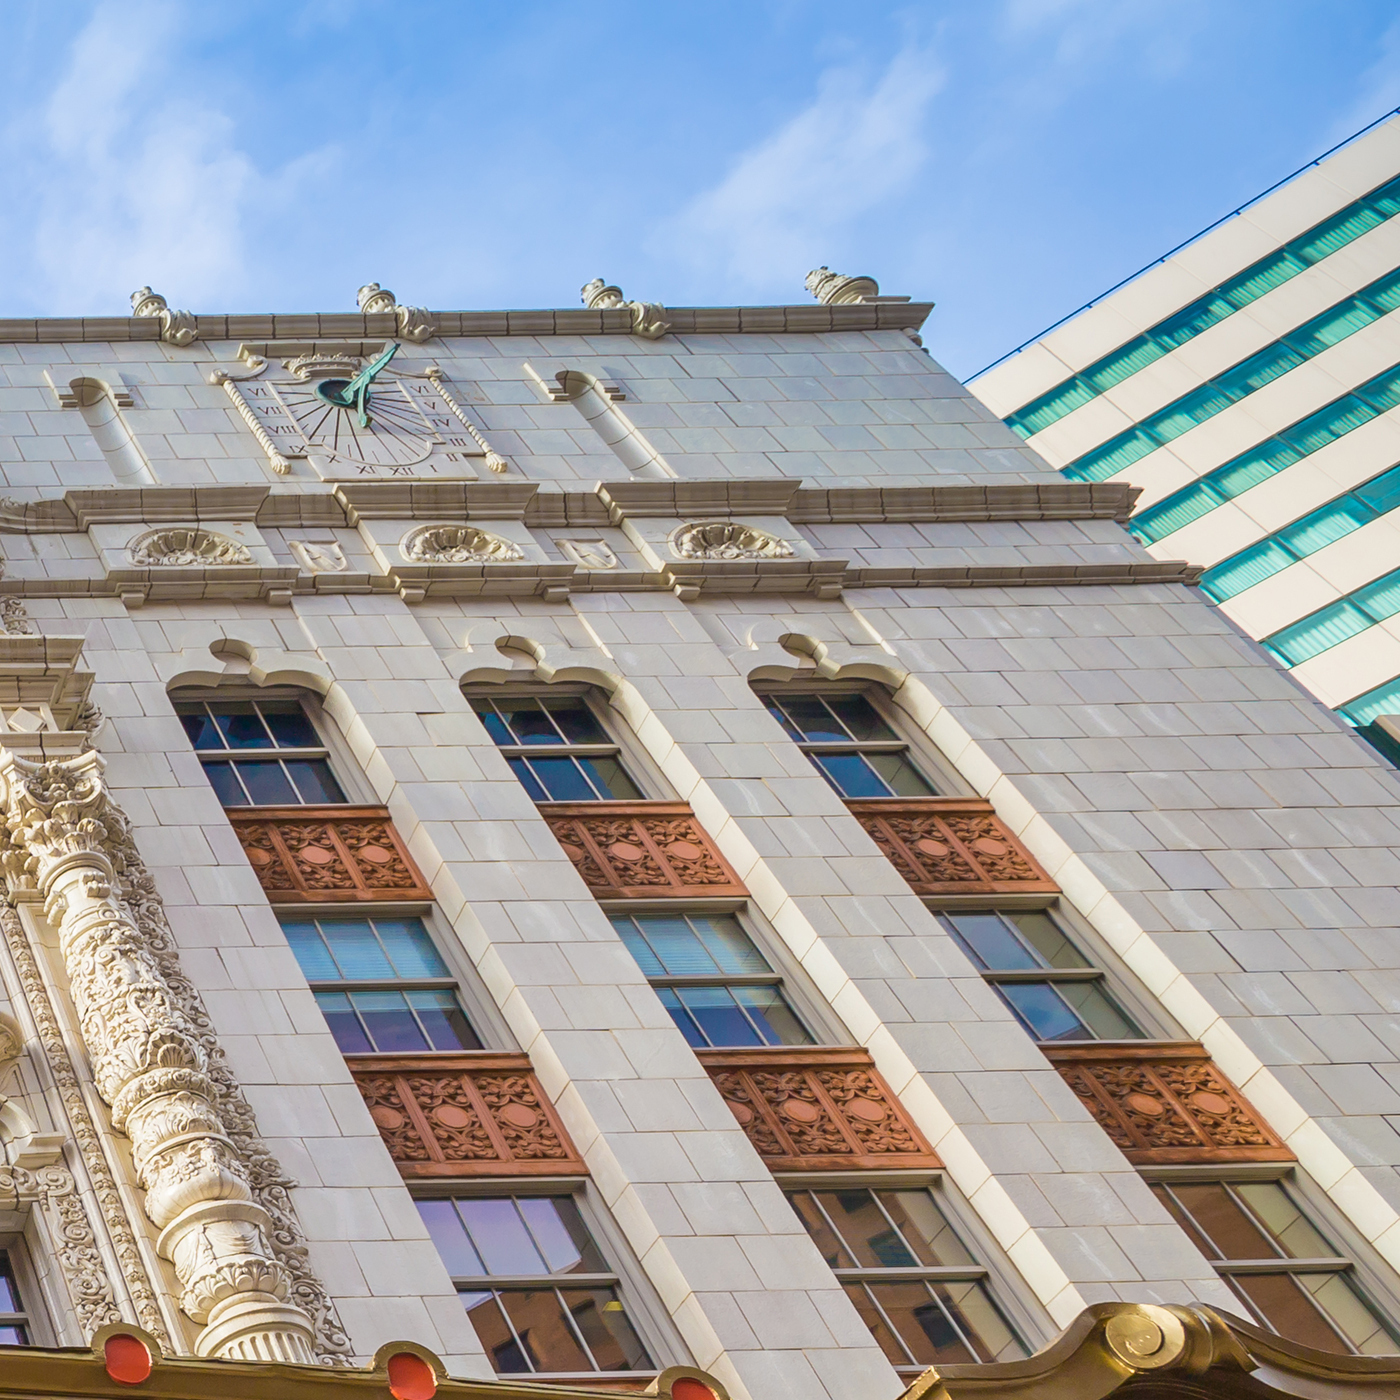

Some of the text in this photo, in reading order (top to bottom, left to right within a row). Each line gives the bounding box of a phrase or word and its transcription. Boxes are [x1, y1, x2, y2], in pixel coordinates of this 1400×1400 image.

[247, 387, 268, 397] VI
[409, 385, 430, 394] VI
[256, 406, 283, 416] VII
[423, 401, 436, 411] V
[432, 418, 450, 428] IV
[266, 425, 299, 435] VIII
[449, 438, 468, 447] III
[288, 445, 310, 454] IX
[325, 454, 343, 464] X
[445, 453, 459, 462] II
[355, 465, 377, 475] XI
[389, 467, 415, 476] XII
